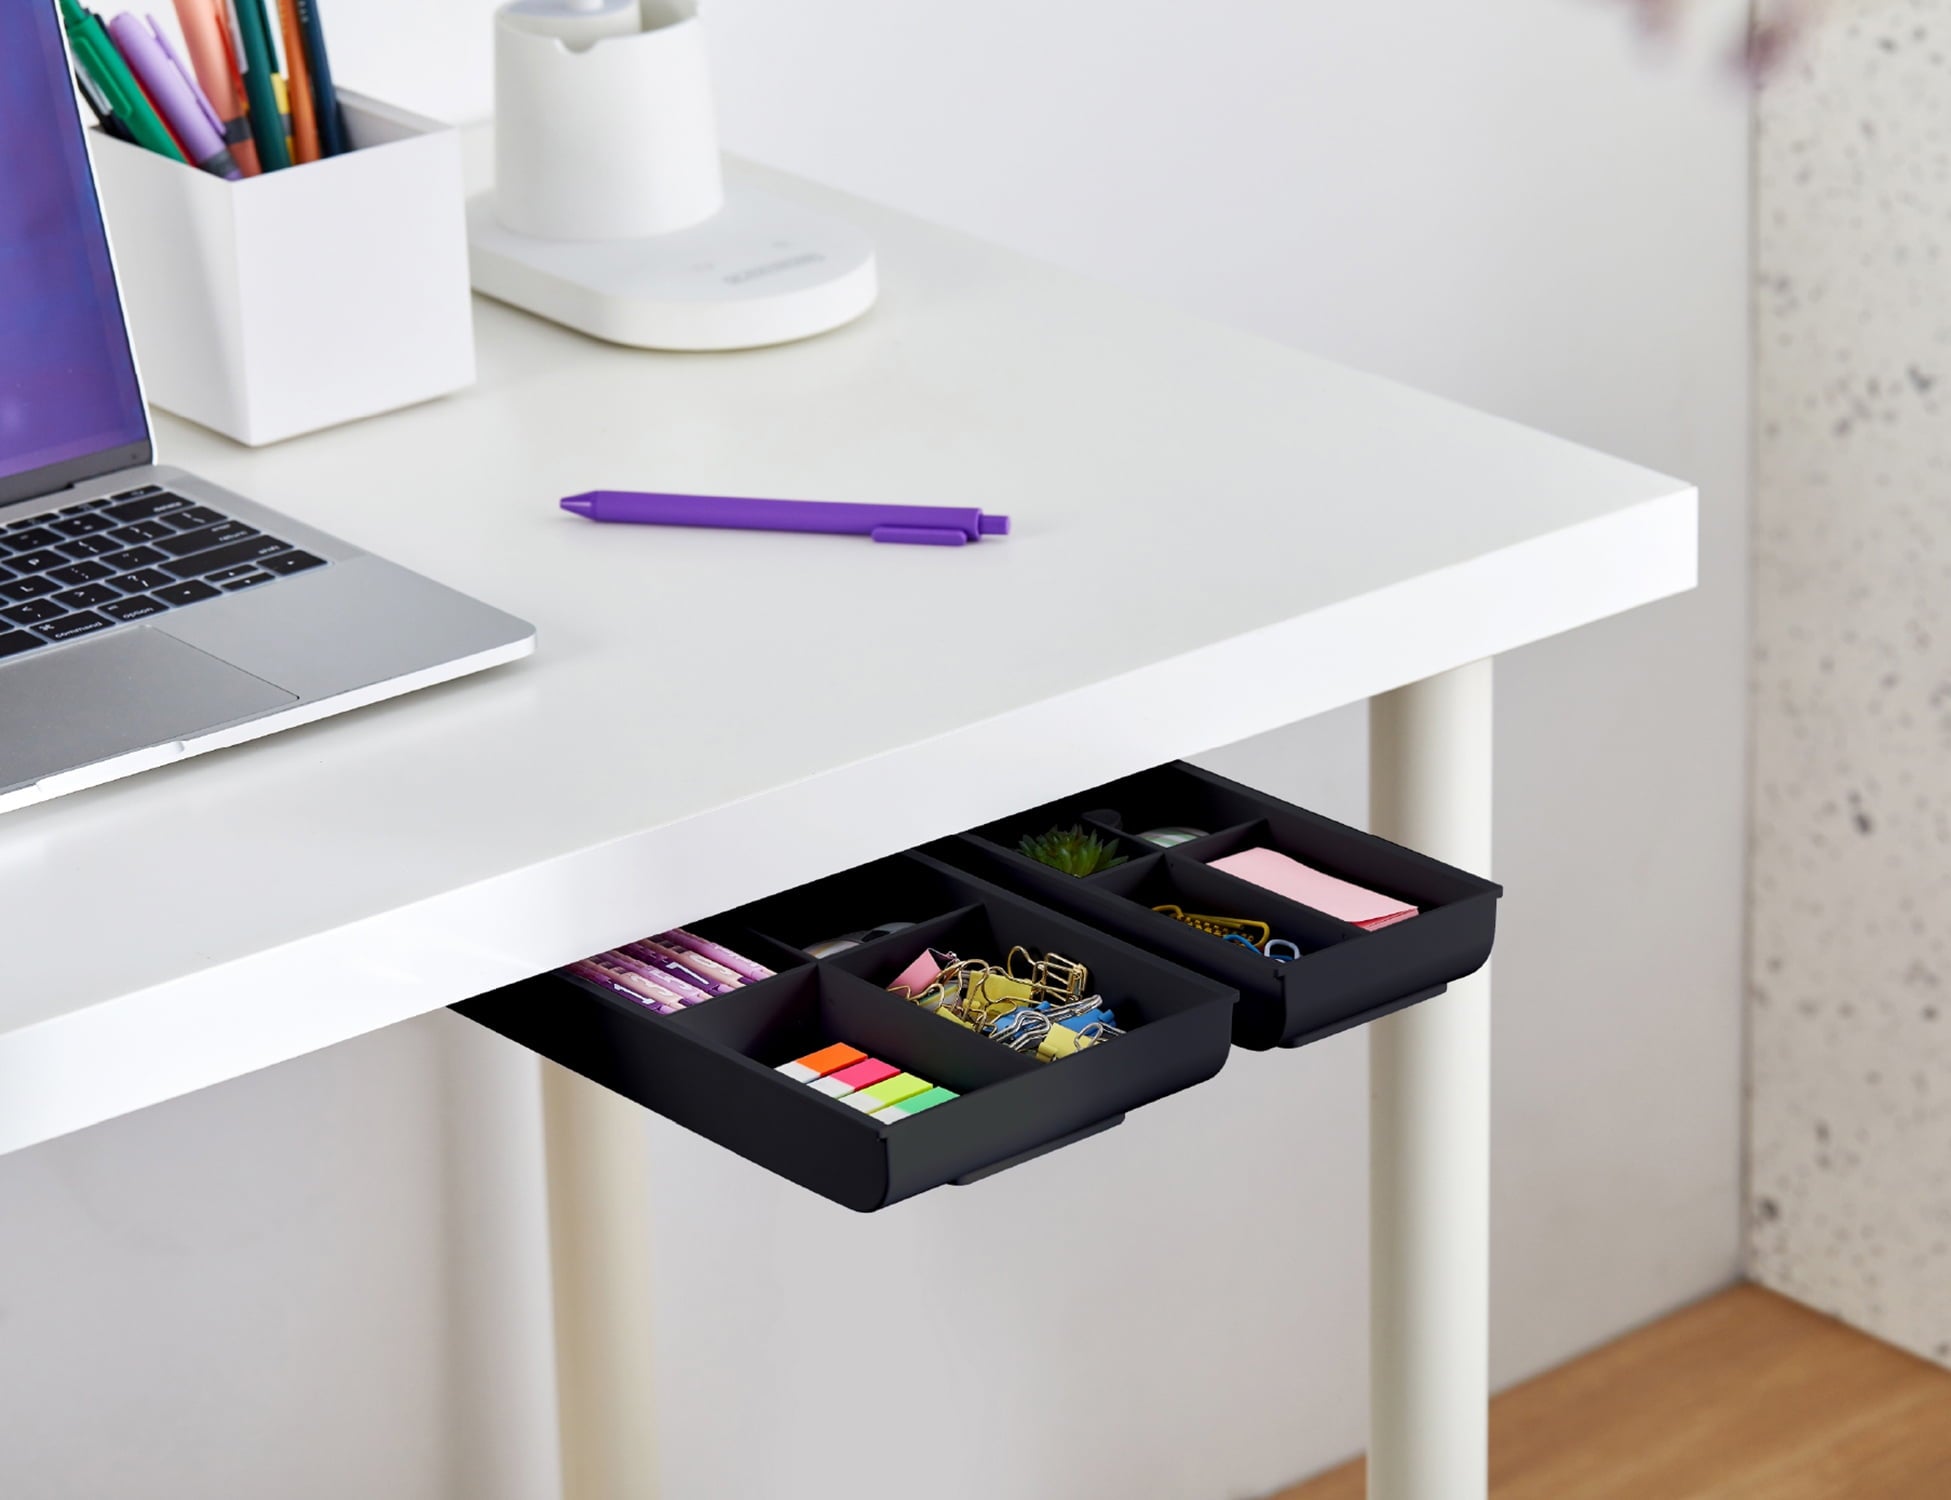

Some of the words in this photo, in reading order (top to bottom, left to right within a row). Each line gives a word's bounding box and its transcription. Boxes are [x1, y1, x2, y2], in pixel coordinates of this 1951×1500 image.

[123, 607, 155, 619] option
[55, 621, 103, 638] command
[666, 961, 709, 984] 7
[614, 983, 655, 1005] 1
